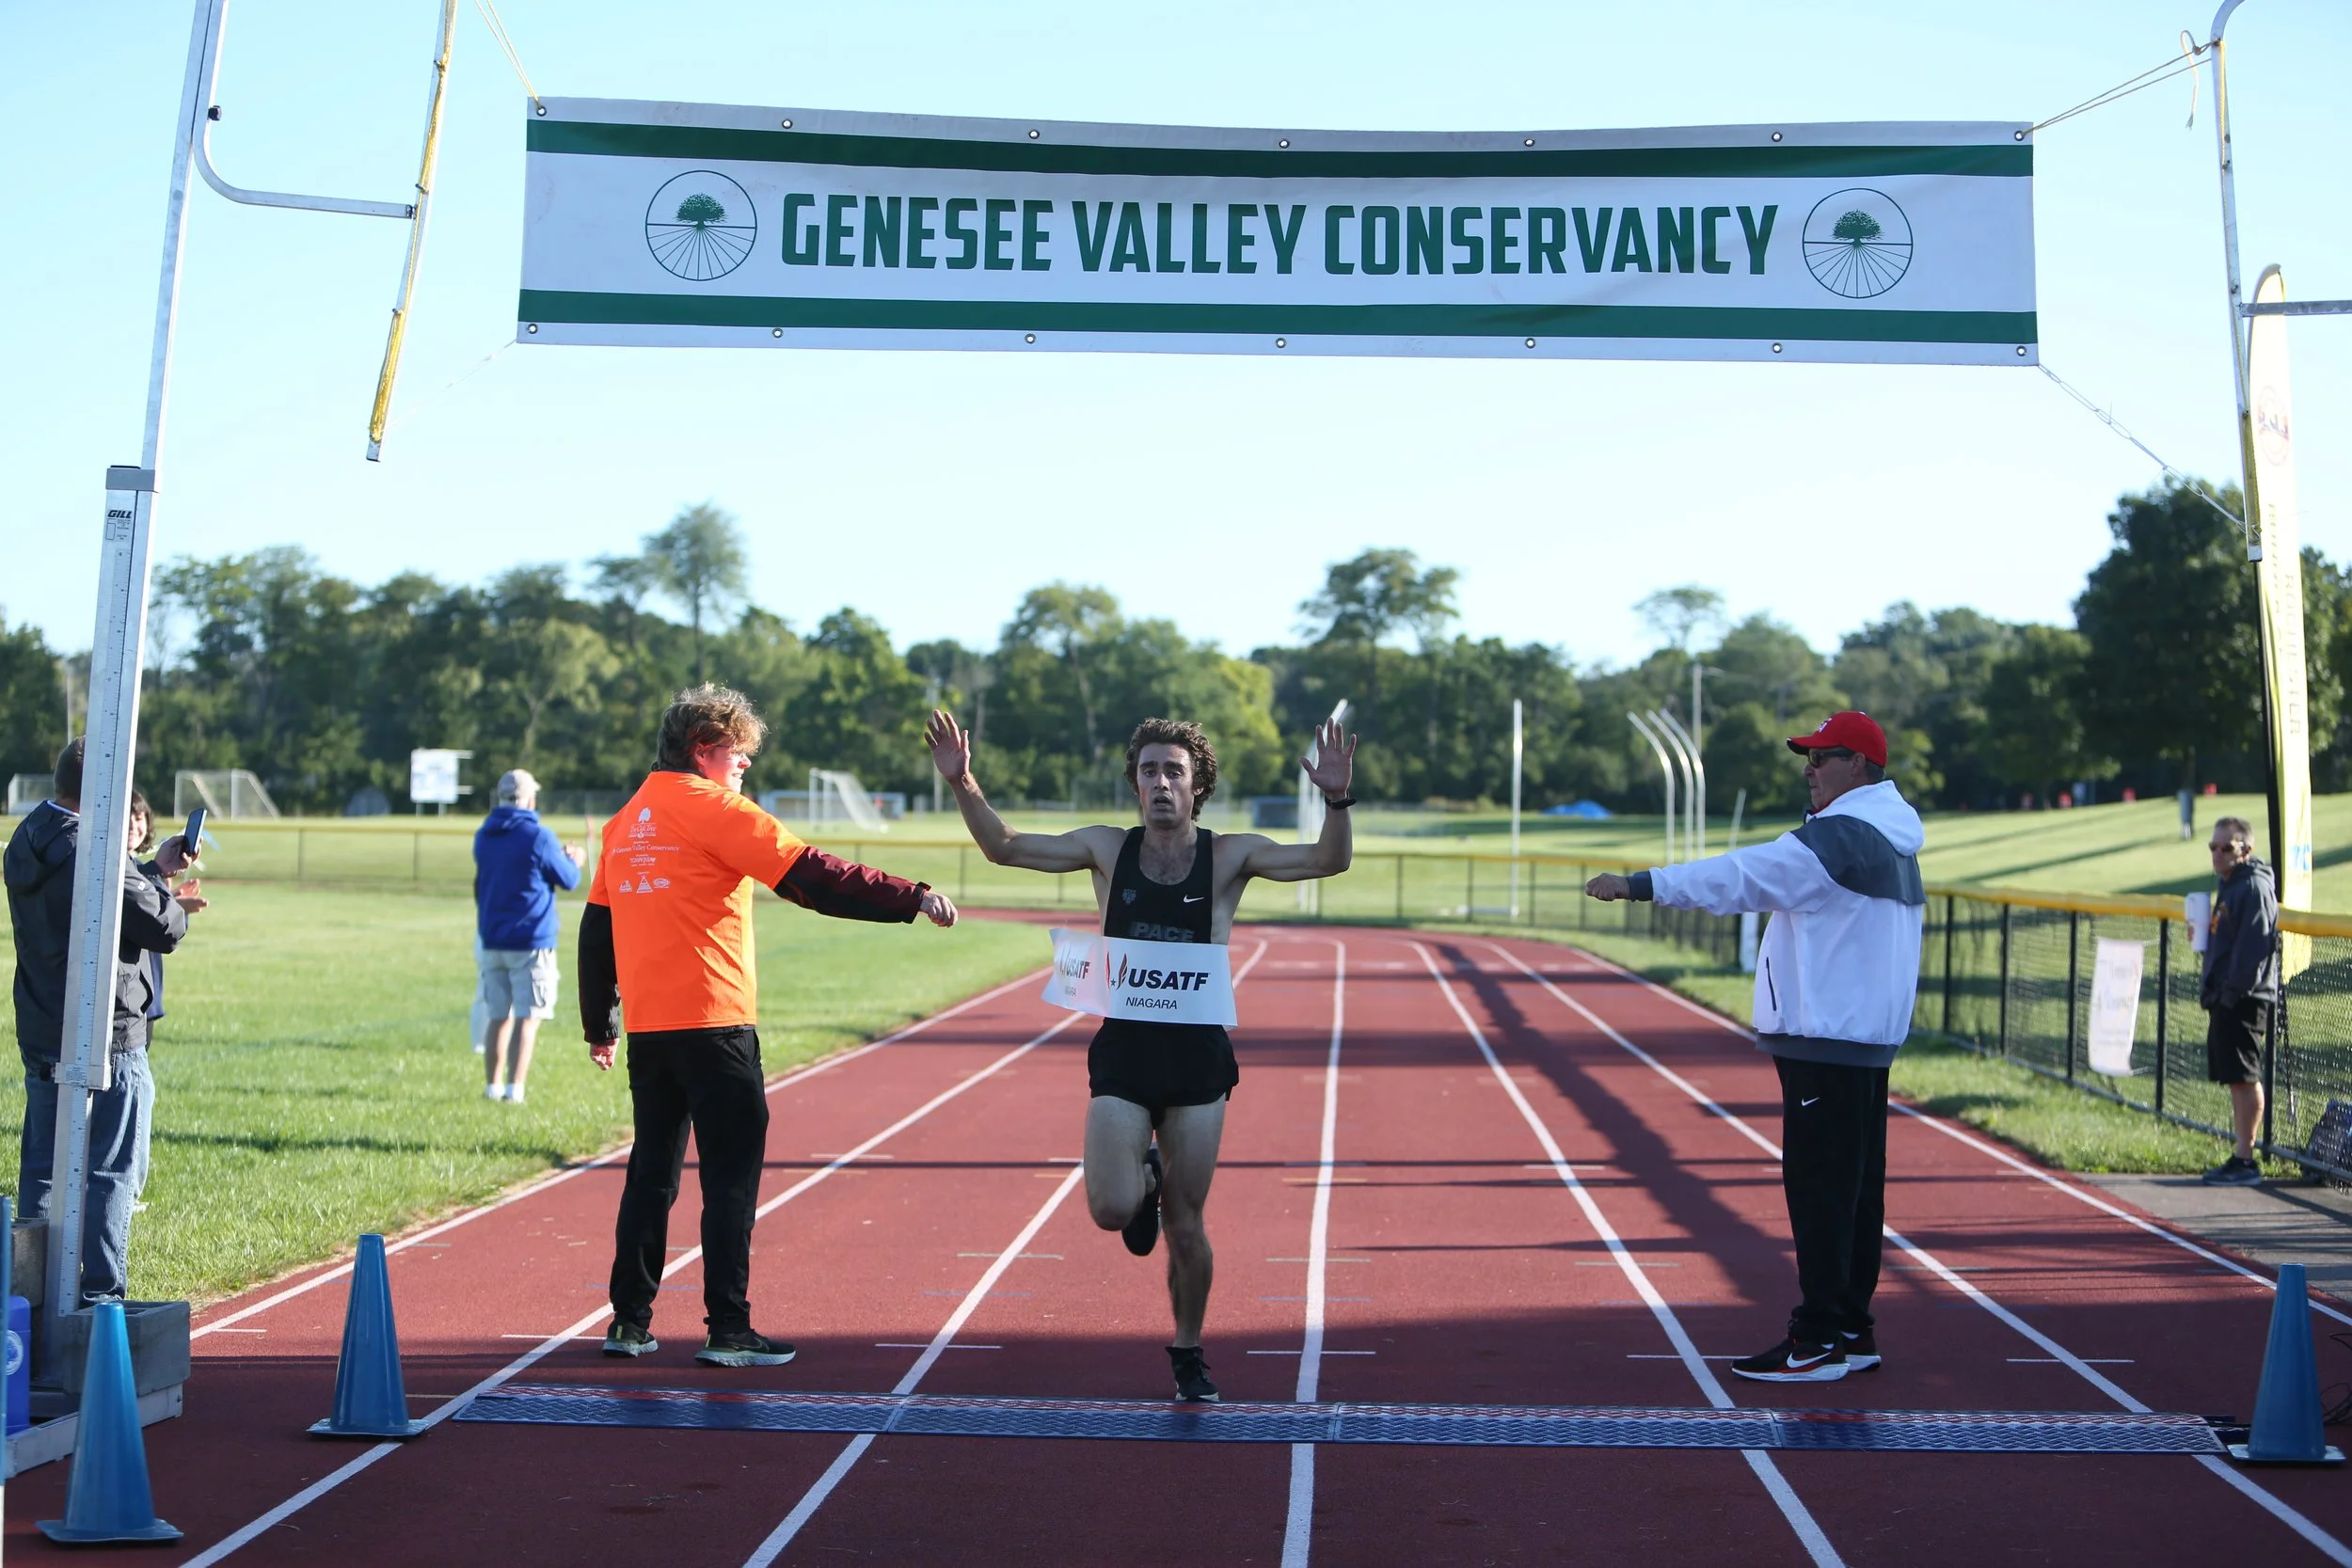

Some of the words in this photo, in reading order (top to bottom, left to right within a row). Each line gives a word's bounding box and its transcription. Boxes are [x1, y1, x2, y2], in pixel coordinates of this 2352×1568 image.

[781, 193, 1053, 271] GENESEE
[1072, 200, 1308, 274] VALLEY
[1324, 204, 1779, 276] CONSERVANCY
[107, 510, 132, 518] GILL
[1131, 921, 1194, 942] PACE
[1129, 969, 1210, 991] USATF
[1125, 997, 1178, 1010] NIAGARA
